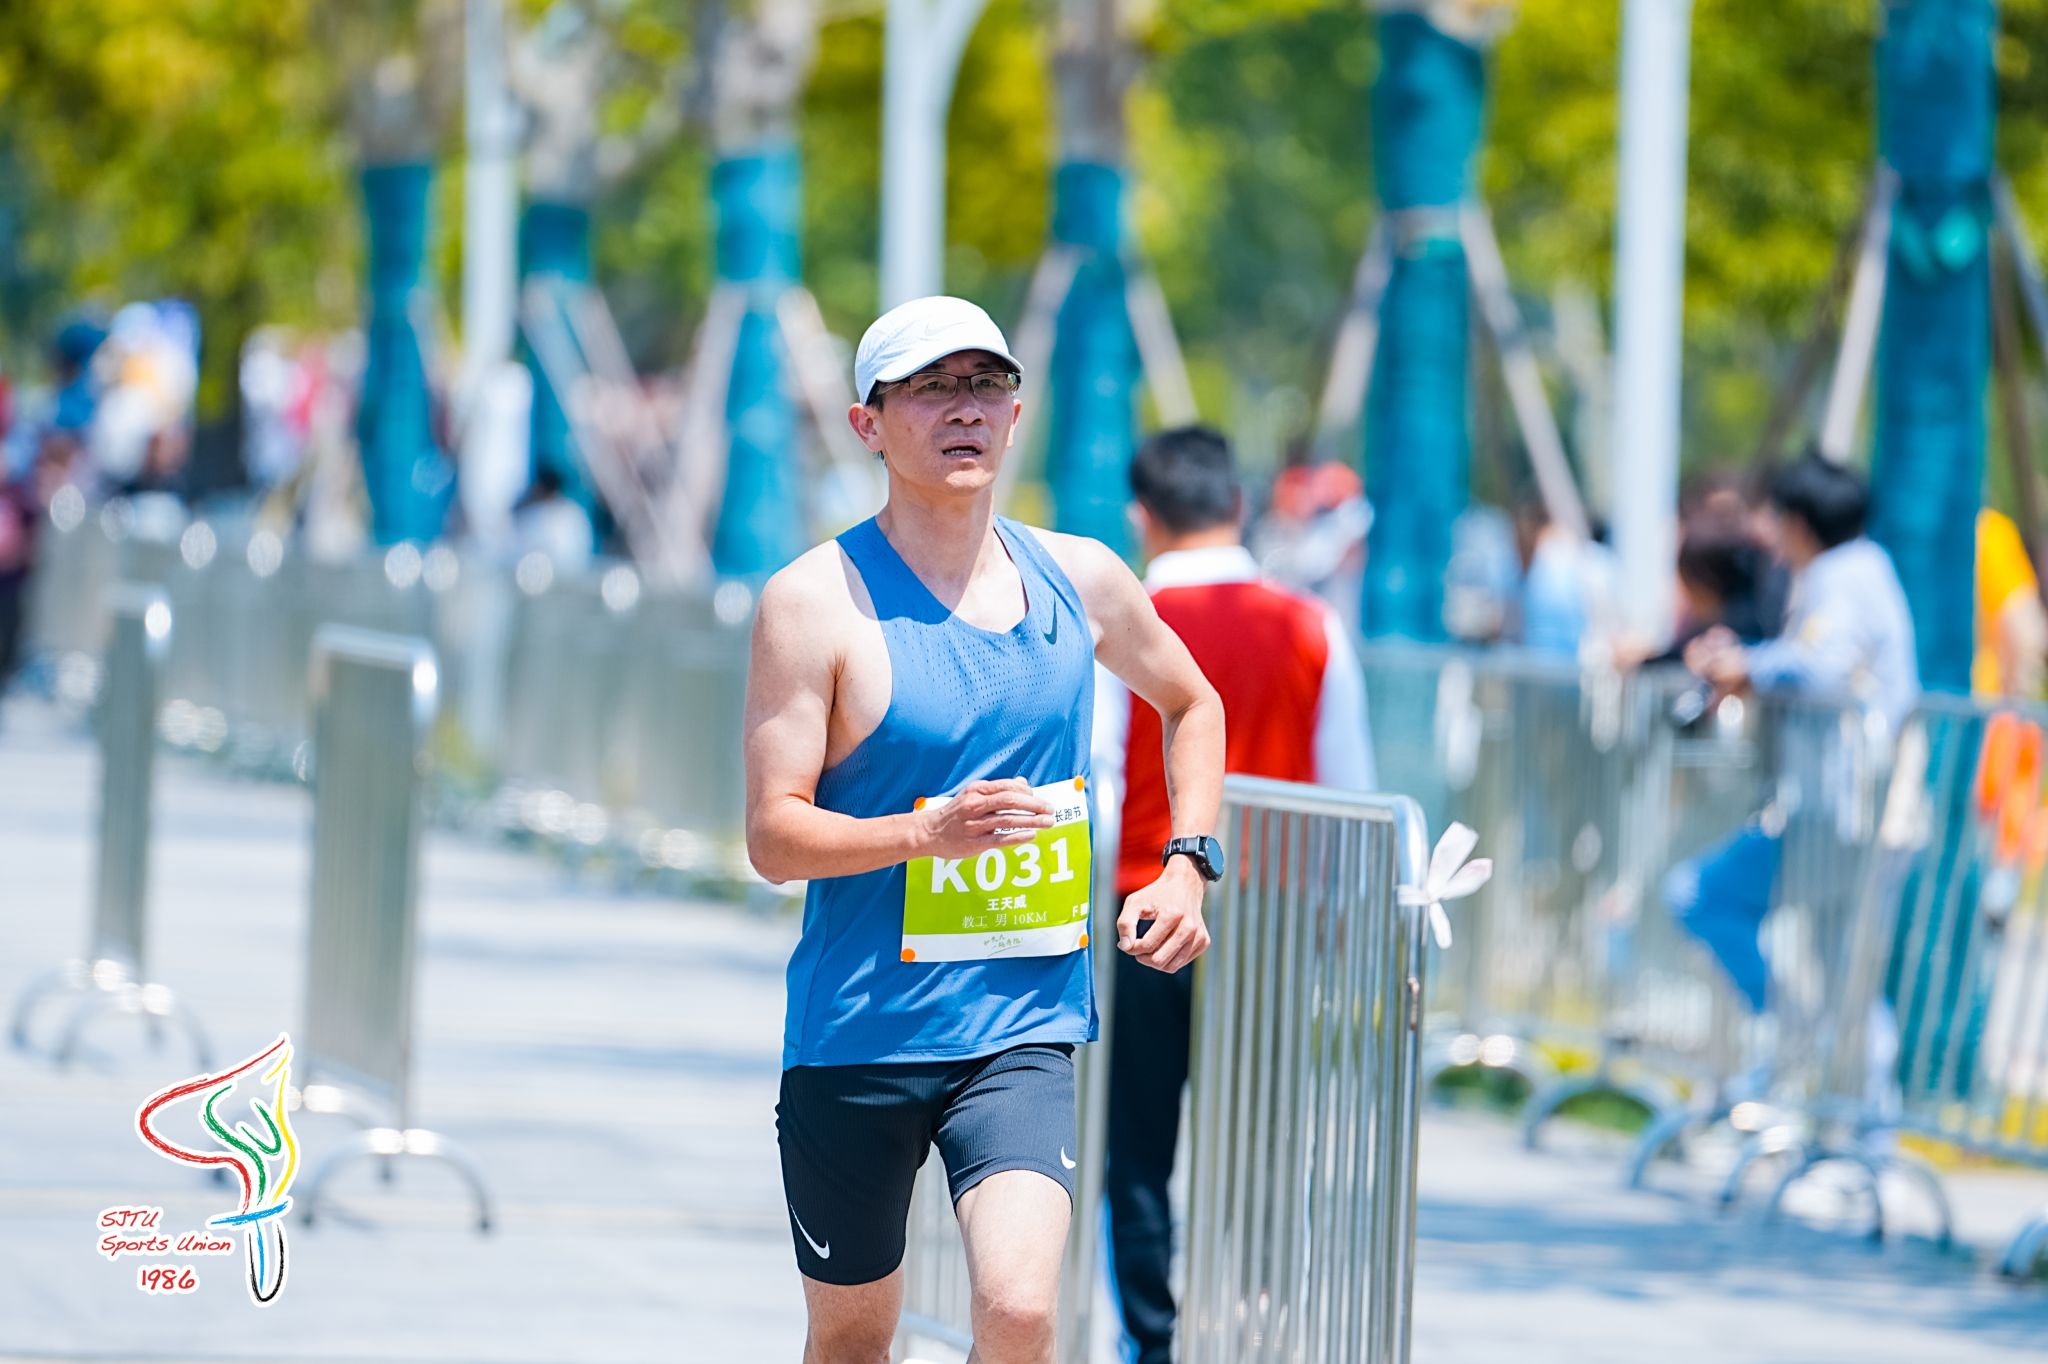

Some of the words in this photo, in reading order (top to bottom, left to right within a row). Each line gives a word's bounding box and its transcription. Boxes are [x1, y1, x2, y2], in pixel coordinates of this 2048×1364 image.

[931, 837, 1075, 894] K031
[962, 914, 988, 928] 教工
[995, 913, 1007, 927] 男
[1013, 911, 1047, 925] 10KM
